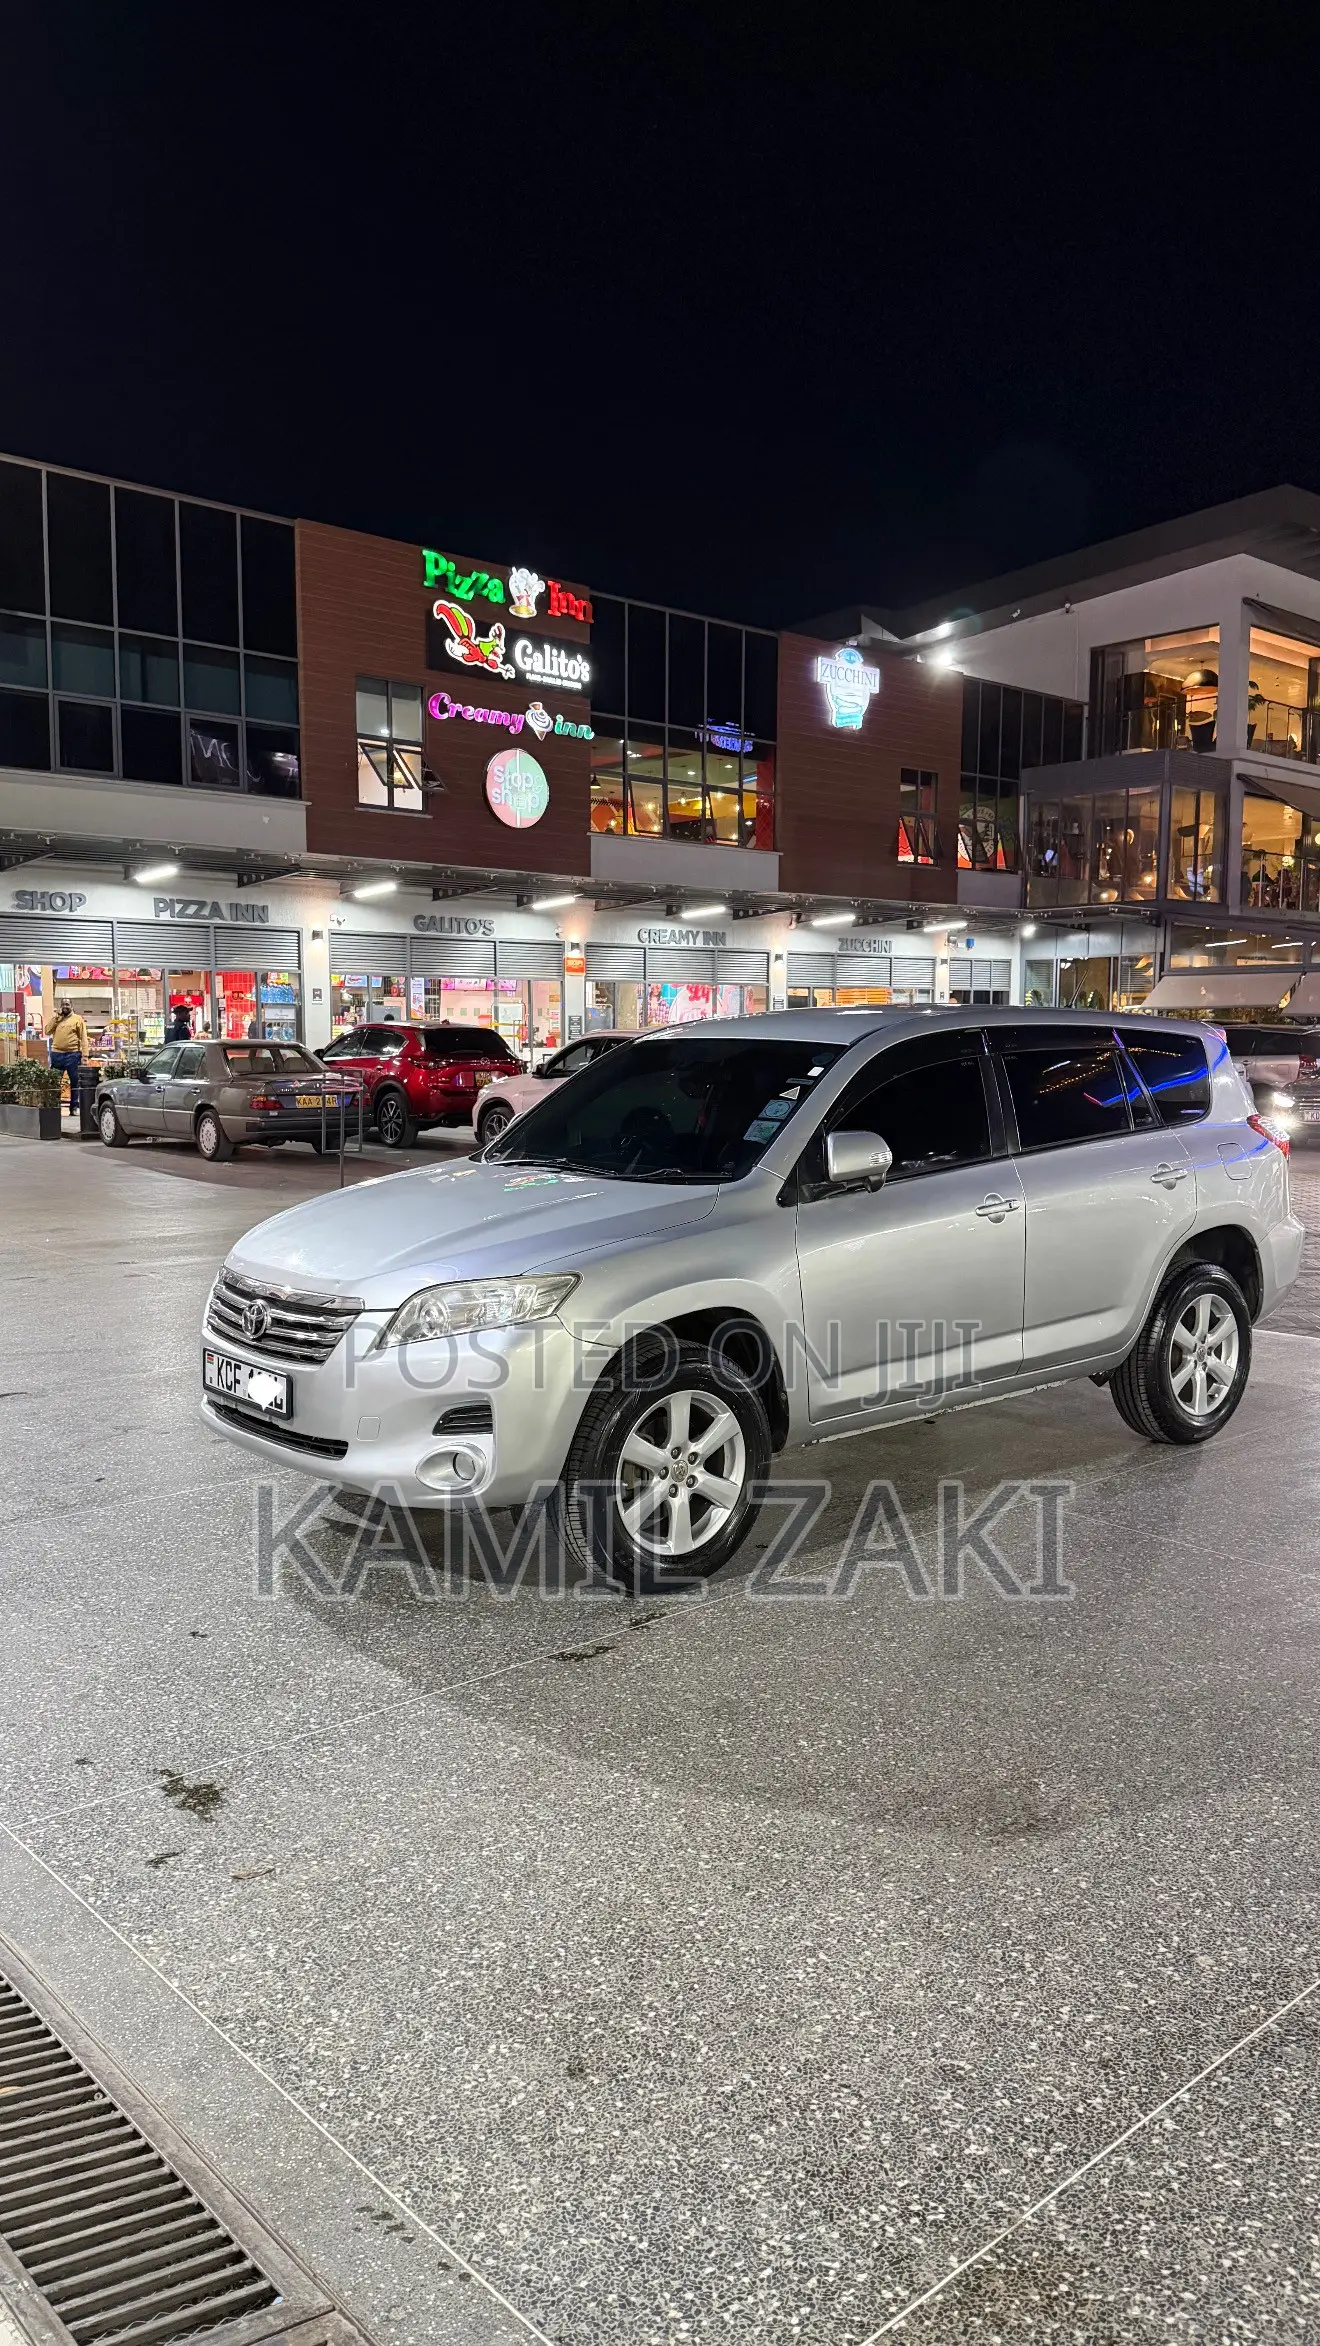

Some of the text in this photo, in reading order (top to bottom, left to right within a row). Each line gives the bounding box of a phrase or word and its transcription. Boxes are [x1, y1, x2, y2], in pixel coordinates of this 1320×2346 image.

[422, 550, 595, 624] Pizza Inn
[514, 638, 591, 683] Galito's
[820, 663, 877, 688] ZUCCHINI
[428, 692, 595, 740] Creamy inn
[14, 890, 87, 913] SHOP
[153, 897, 269, 923] PIZZA INN
[413, 914, 495, 936] GALITO'S
[637, 928, 727, 947] CREAMY INN
[837, 937, 893, 954] ZUCCHINI
[217, 1357, 242, 1394] KCF
